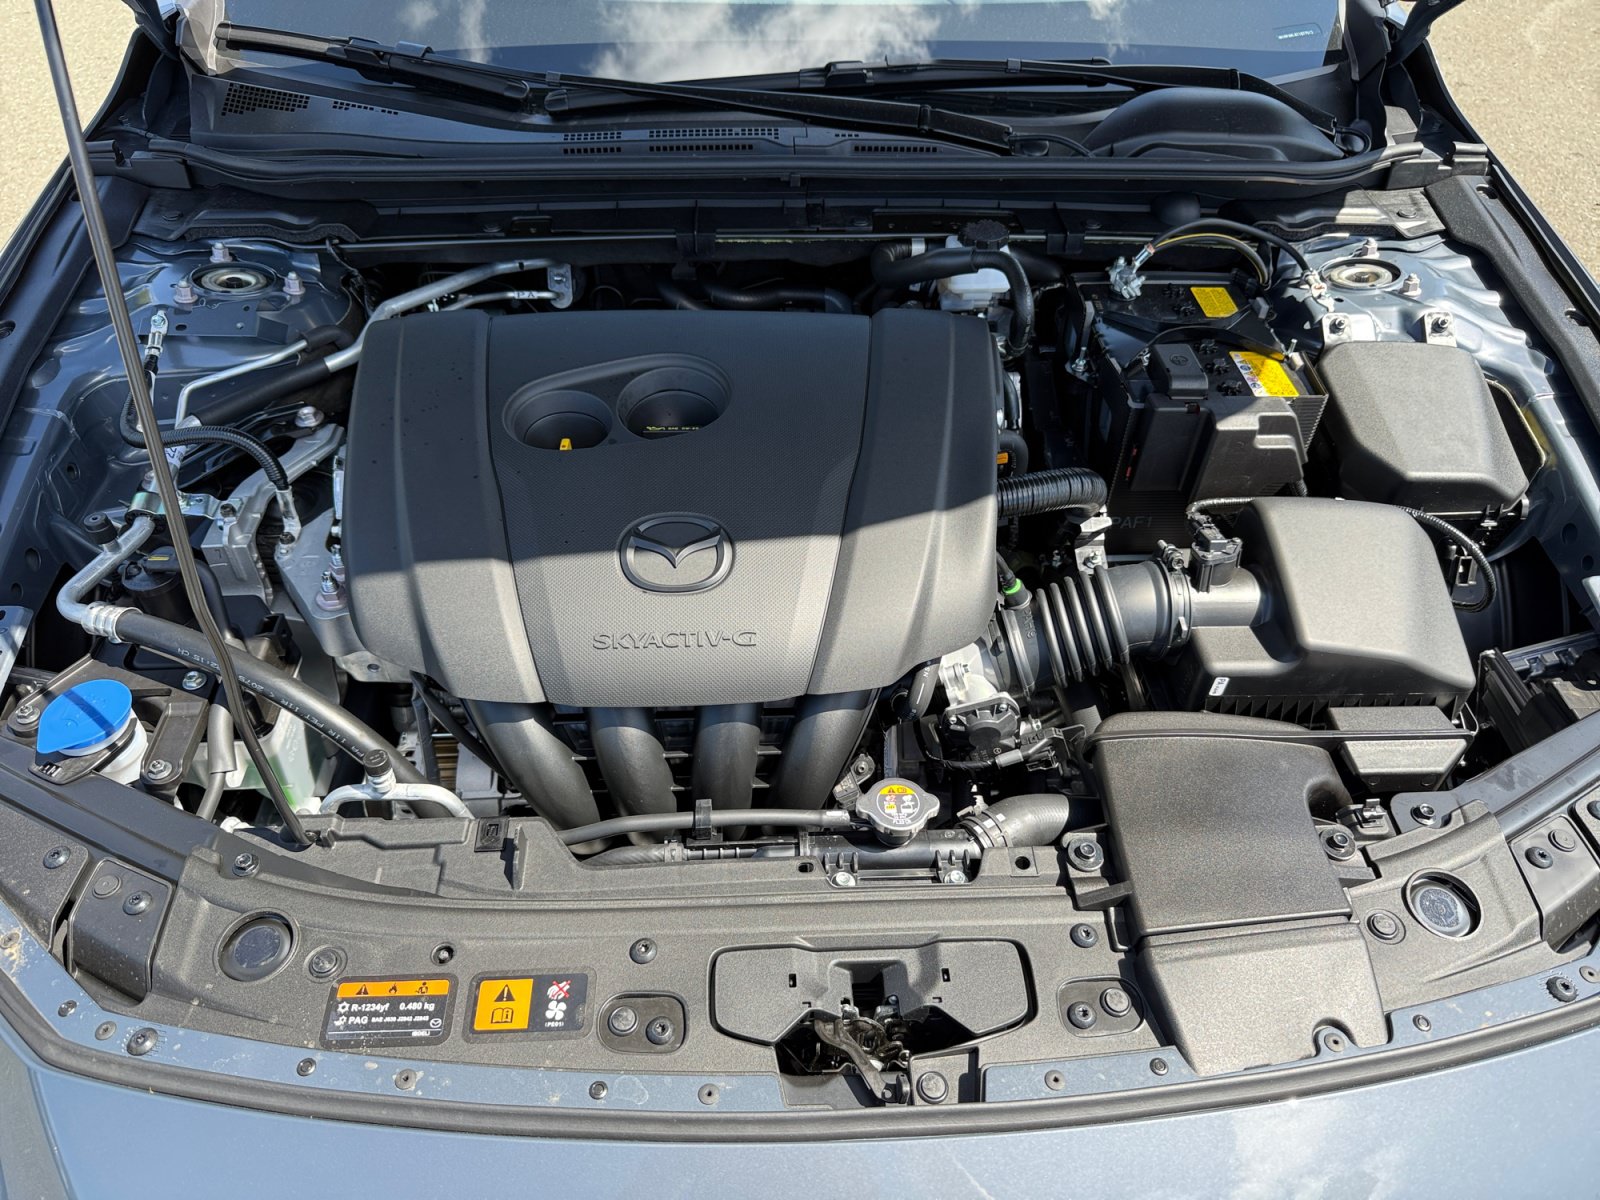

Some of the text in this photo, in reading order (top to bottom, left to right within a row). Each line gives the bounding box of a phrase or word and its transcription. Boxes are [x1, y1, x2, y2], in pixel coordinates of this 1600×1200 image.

[592, 630, 757, 650] SKYACTIV-G
[351, 1002, 435, 1012] R-1234yf 0.480 kg
[348, 1016, 369, 1024] PAG
